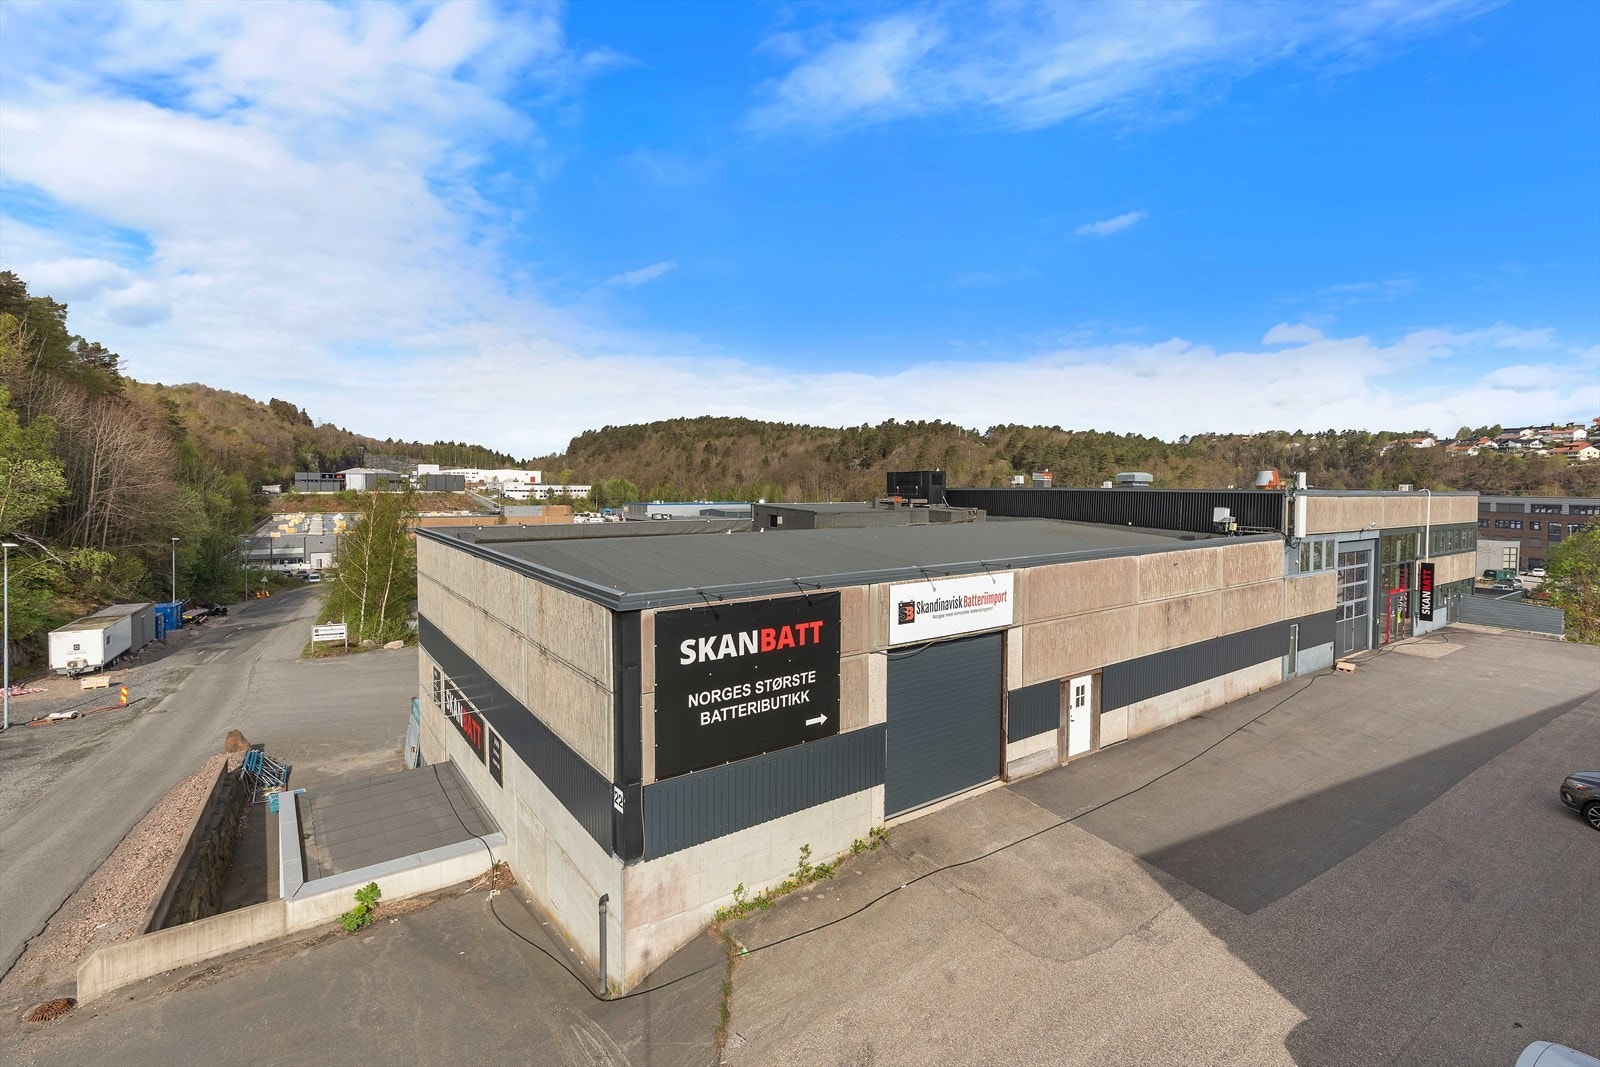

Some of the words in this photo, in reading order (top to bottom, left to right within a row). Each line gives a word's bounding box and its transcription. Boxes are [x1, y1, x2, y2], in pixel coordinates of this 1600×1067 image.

[916, 596, 963, 615] Skandinavisk
[963, 591, 1007, 608] Batteriimport
[1422, 569, 1432, 615] SKANBATT
[680, 620, 824, 665] SKANBATT
[688, 683, 751, 708] NORGES
[755, 670, 816, 695] STØRSTE
[700, 689, 810, 726] BATTERIBUTIKK
[445, 688, 482, 750] SKANBATT
[614, 790, 623, 808] 22
